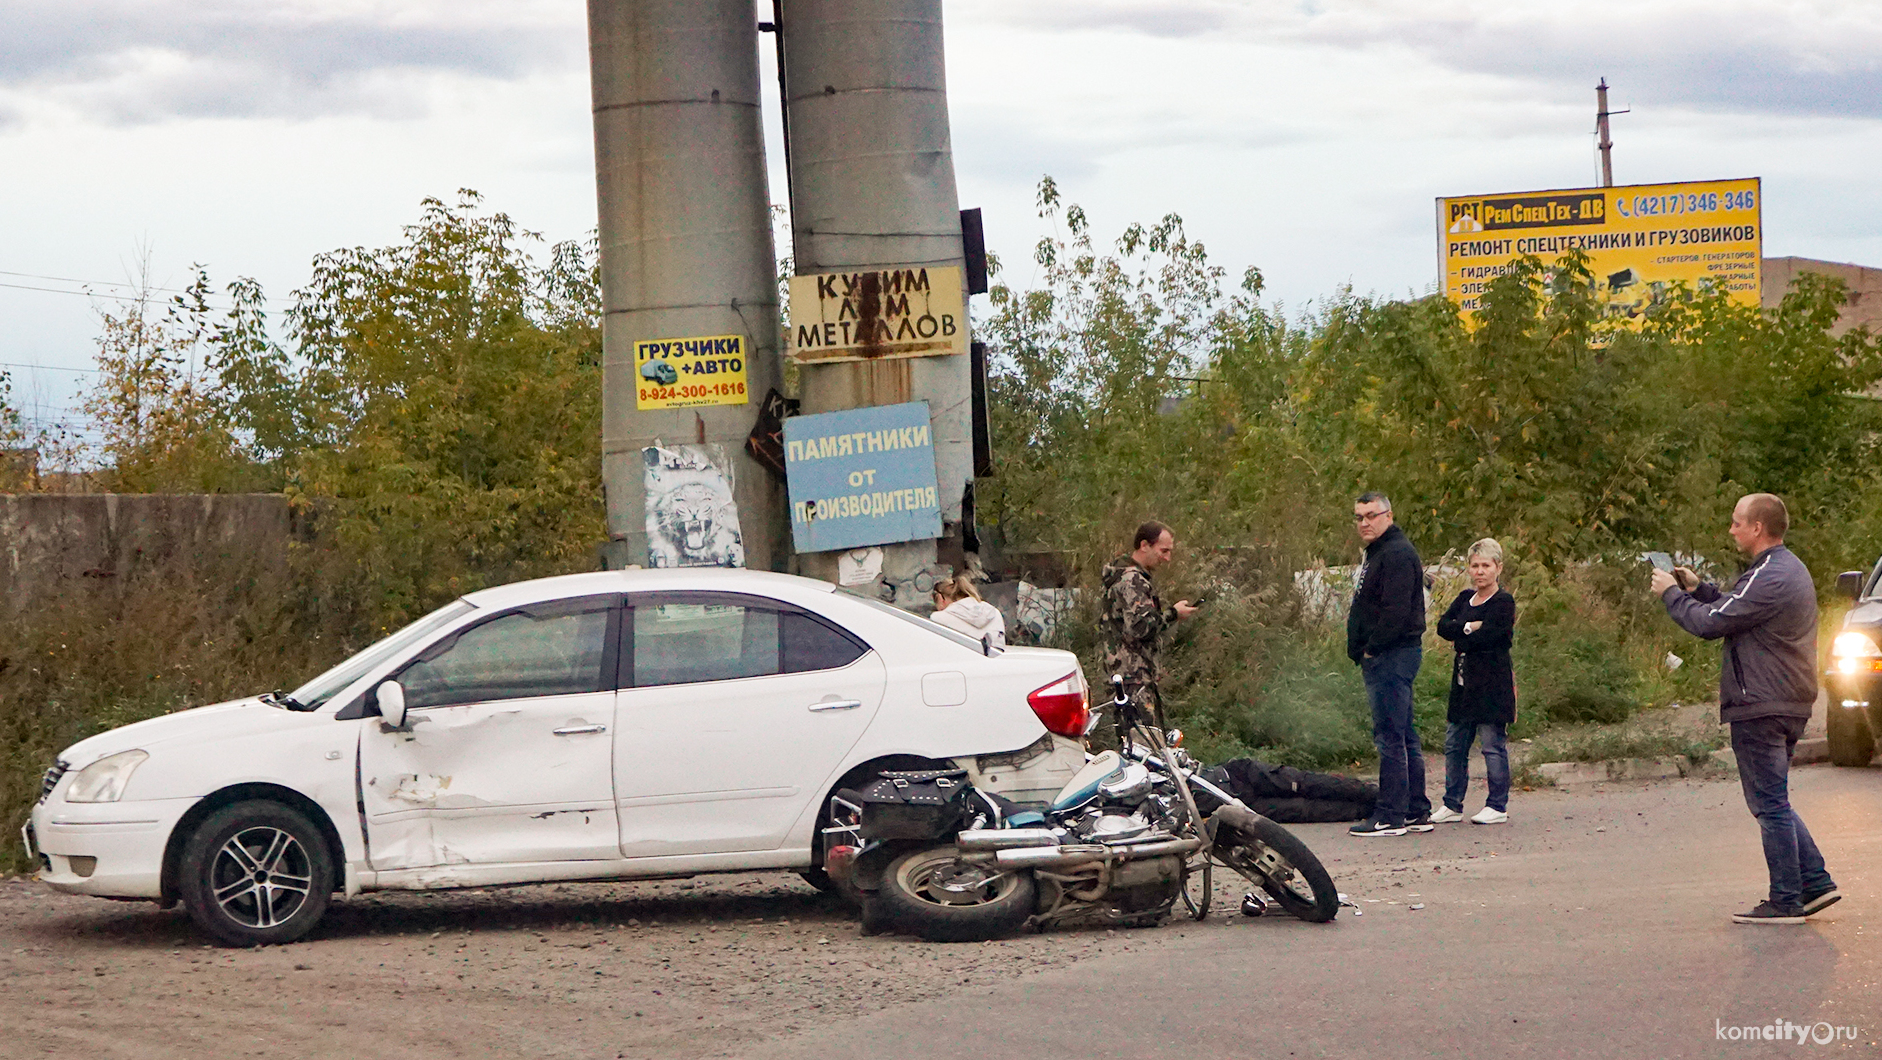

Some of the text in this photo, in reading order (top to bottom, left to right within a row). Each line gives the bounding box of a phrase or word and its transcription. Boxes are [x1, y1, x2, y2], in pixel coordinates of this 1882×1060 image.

[1632, 190, 1755, 218] (4217) 346-346
[1449, 224, 1755, 257] РЕМОНТ СПЕЦТЕХНИКИ И ГРУЗОВИКОВ
[1703, 251, 1755, 261] ГЕНЕРАТОРОВ
[817, 267, 930, 299] КУИМ
[838, 292, 911, 321] ЛМ
[638, 337, 740, 360] ГРУЗЧИКИ
[681, 358, 742, 375] +АВТО
[639, 381, 745, 401] 8-924-300-1616
[788, 425, 929, 462] ПАМЯТНИКИ
[794, 486, 937, 524] ПРОИЗВОДИТЕЛЯ
